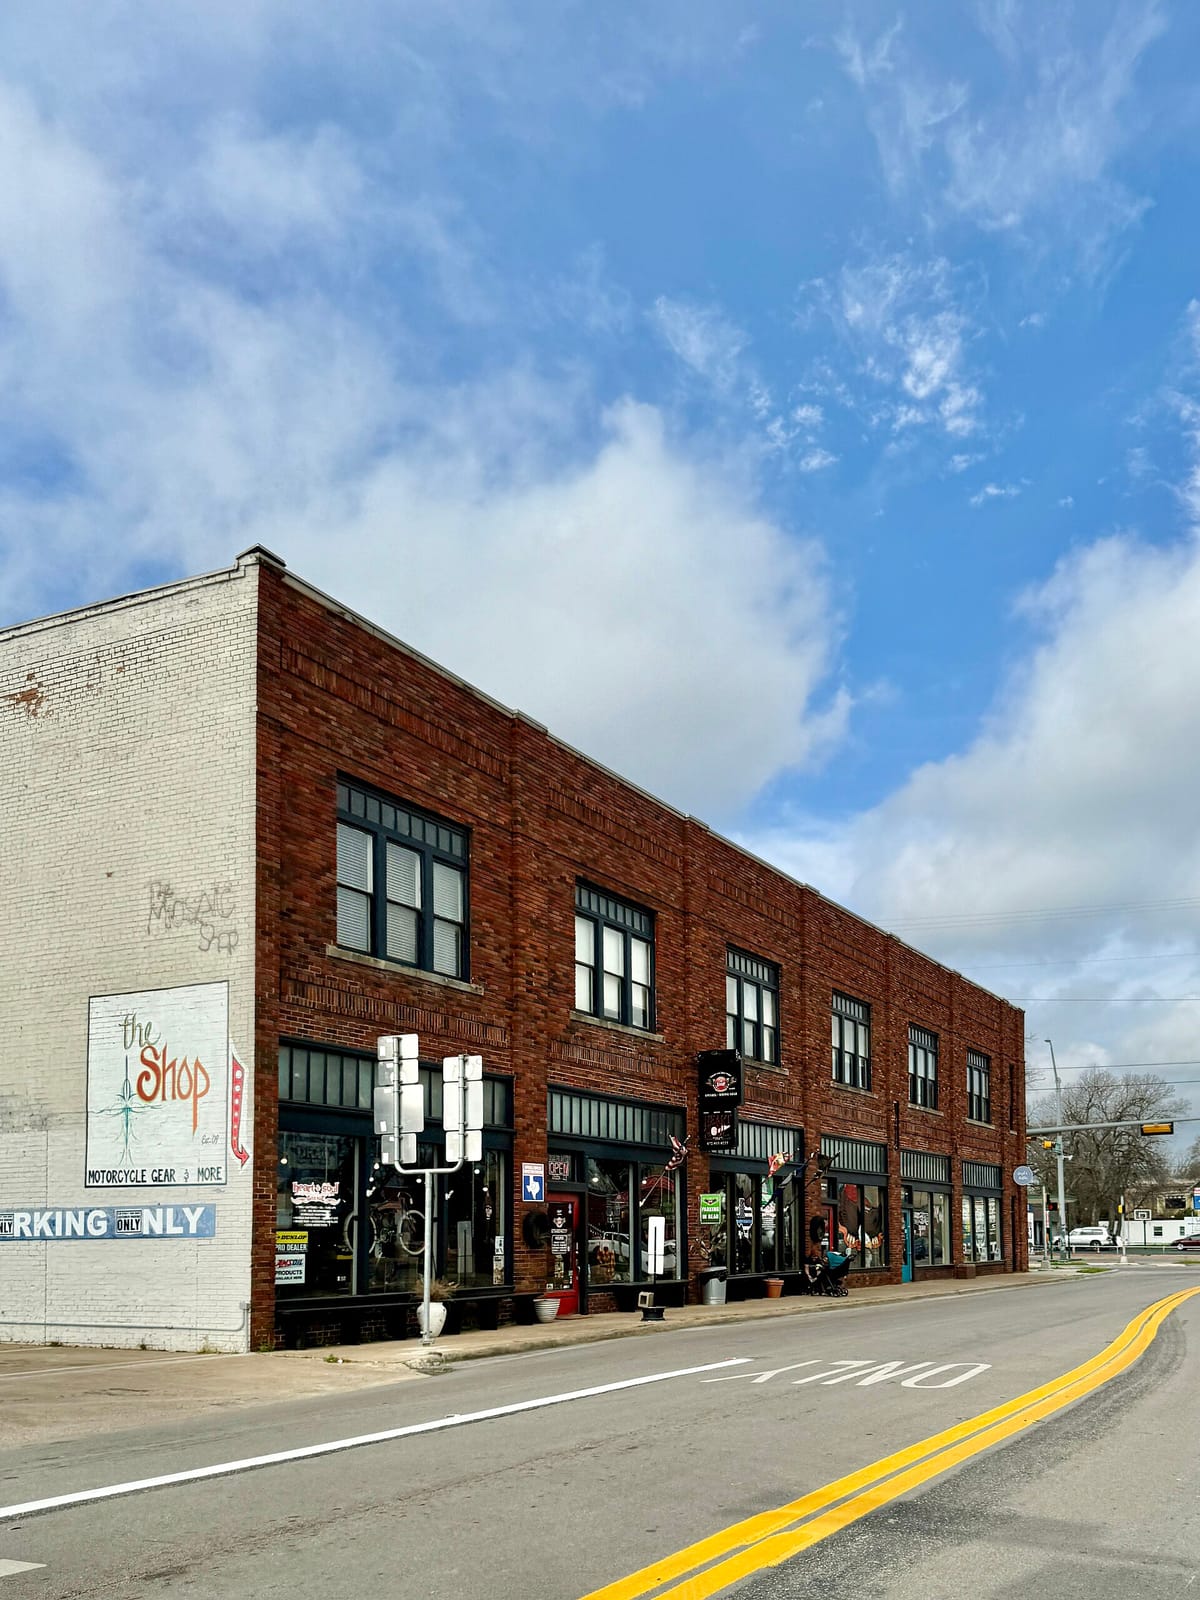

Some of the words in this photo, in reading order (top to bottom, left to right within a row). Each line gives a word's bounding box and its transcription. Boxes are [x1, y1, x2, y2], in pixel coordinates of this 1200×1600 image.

[118, 1012, 161, 1050] the
[136, 1042, 211, 1136] Shop
[88, 1169, 147, 1184] MOTORCYCLE
[151, 1168, 176, 1183] GEAR
[184, 1169, 190, 1182] &
[197, 1166, 222, 1181] MORE
[13, 1209, 108, 1238] RKING
[142, 1206, 206, 1235] NLY
[117, 1218, 141, 1231] ONLY
[286, 1243, 308, 1252] DEALER
[700, 1359, 993, 1389] ONLY
